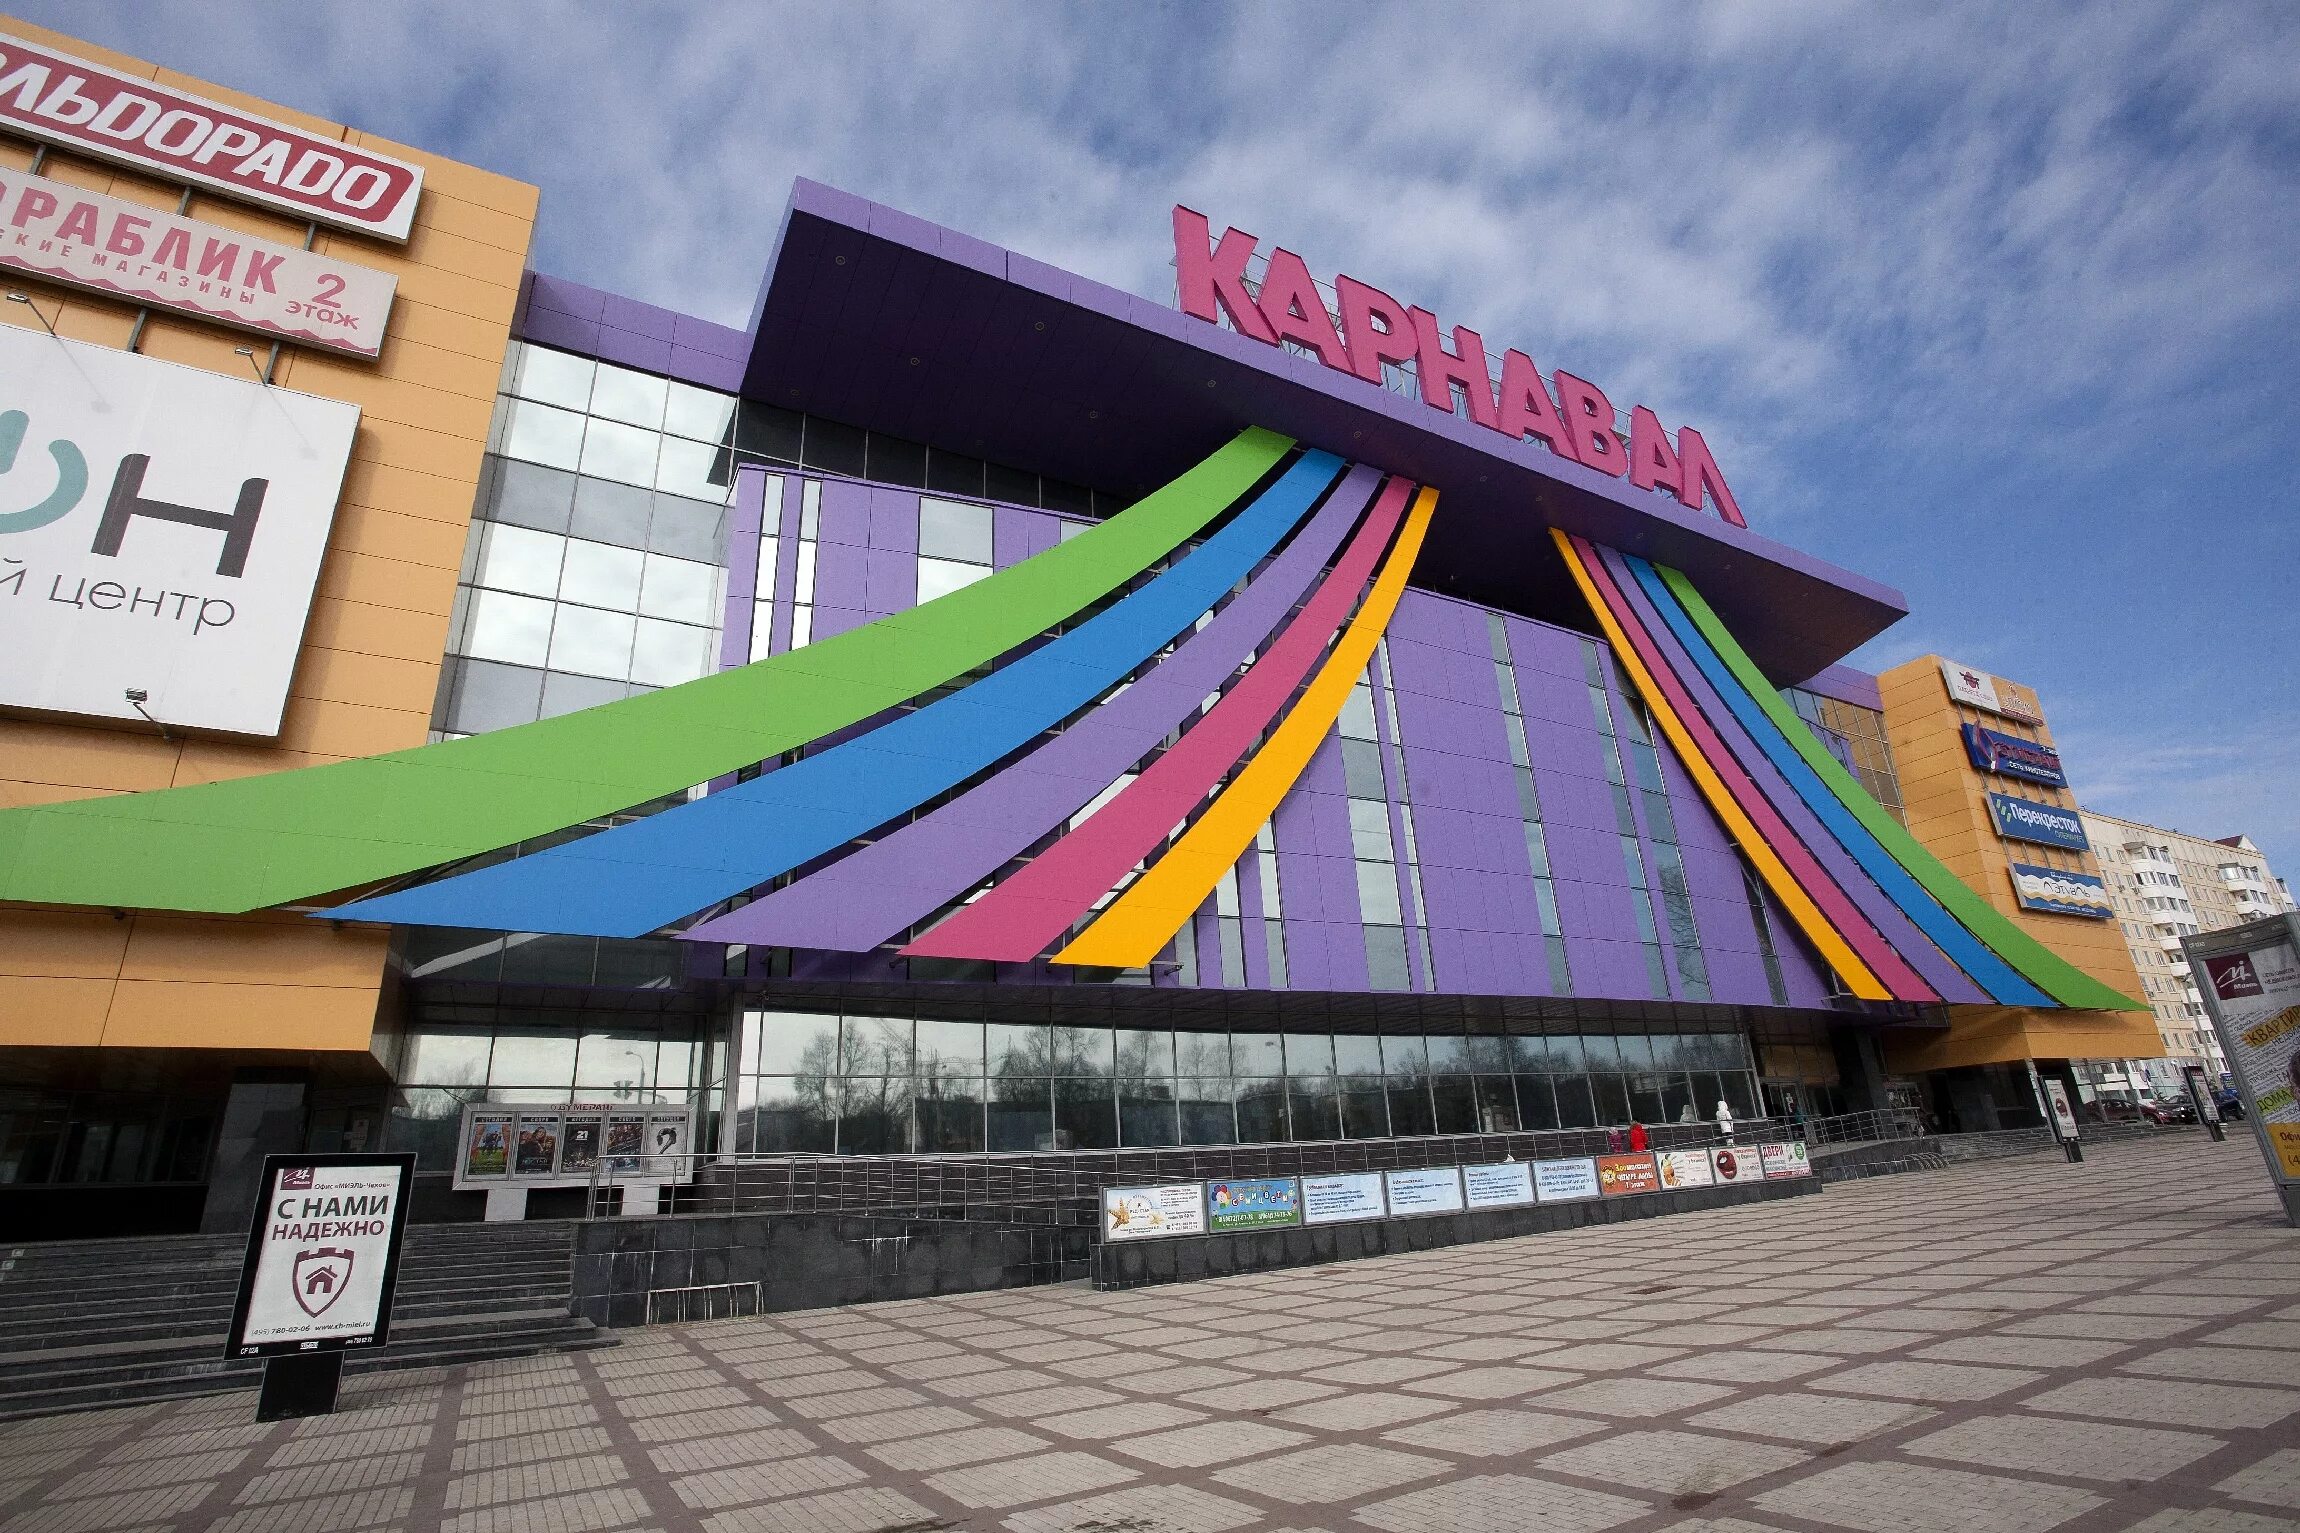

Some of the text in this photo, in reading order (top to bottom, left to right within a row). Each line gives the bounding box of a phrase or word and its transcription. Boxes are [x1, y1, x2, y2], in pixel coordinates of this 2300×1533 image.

[92, 252, 256, 305] МАГАЗИНЫ
[311, 274, 347, 308] 2
[285, 300, 360, 330] этаж
[1172, 204, 1747, 528] КАРНАВАЛ
[49, 573, 236, 635] центр
[2009, 802, 2081, 834] Перекресток
[2256, 1089, 2292, 1111] ДОМА
[1762, 1145, 1784, 1159] ДВЕРИ
[278, 1195, 389, 1219] С НАМИ
[272, 1219, 385, 1242] НАДЕЖНО
